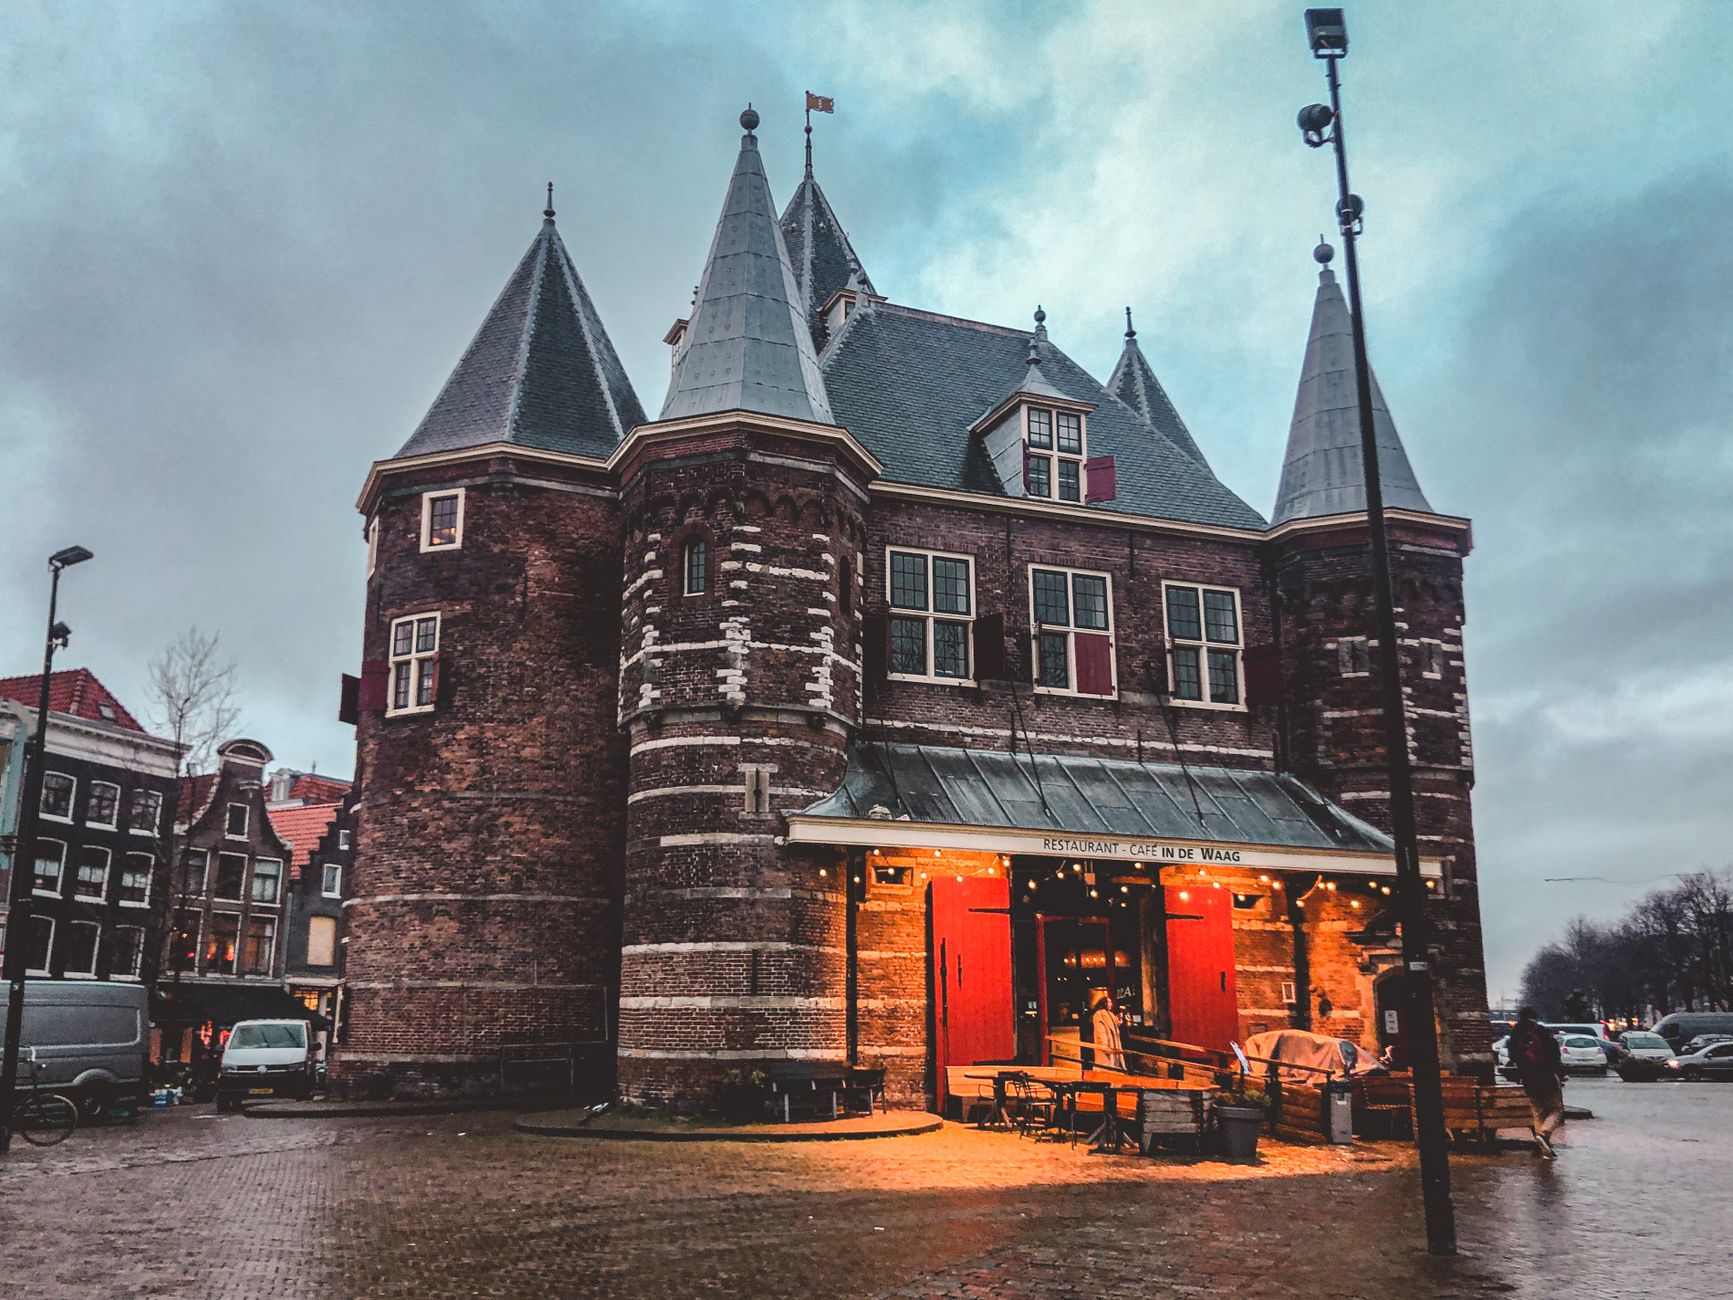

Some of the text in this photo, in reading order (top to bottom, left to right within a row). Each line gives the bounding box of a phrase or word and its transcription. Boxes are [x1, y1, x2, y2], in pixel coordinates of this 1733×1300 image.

[1044, 838, 1119, 854] RESTAURANT
[1129, 843, 1157, 857] CAFÉ
[1162, 847, 1174, 858] IN
[1178, 848, 1194, 860] DE
[1200, 847, 1240, 862] WAAG
